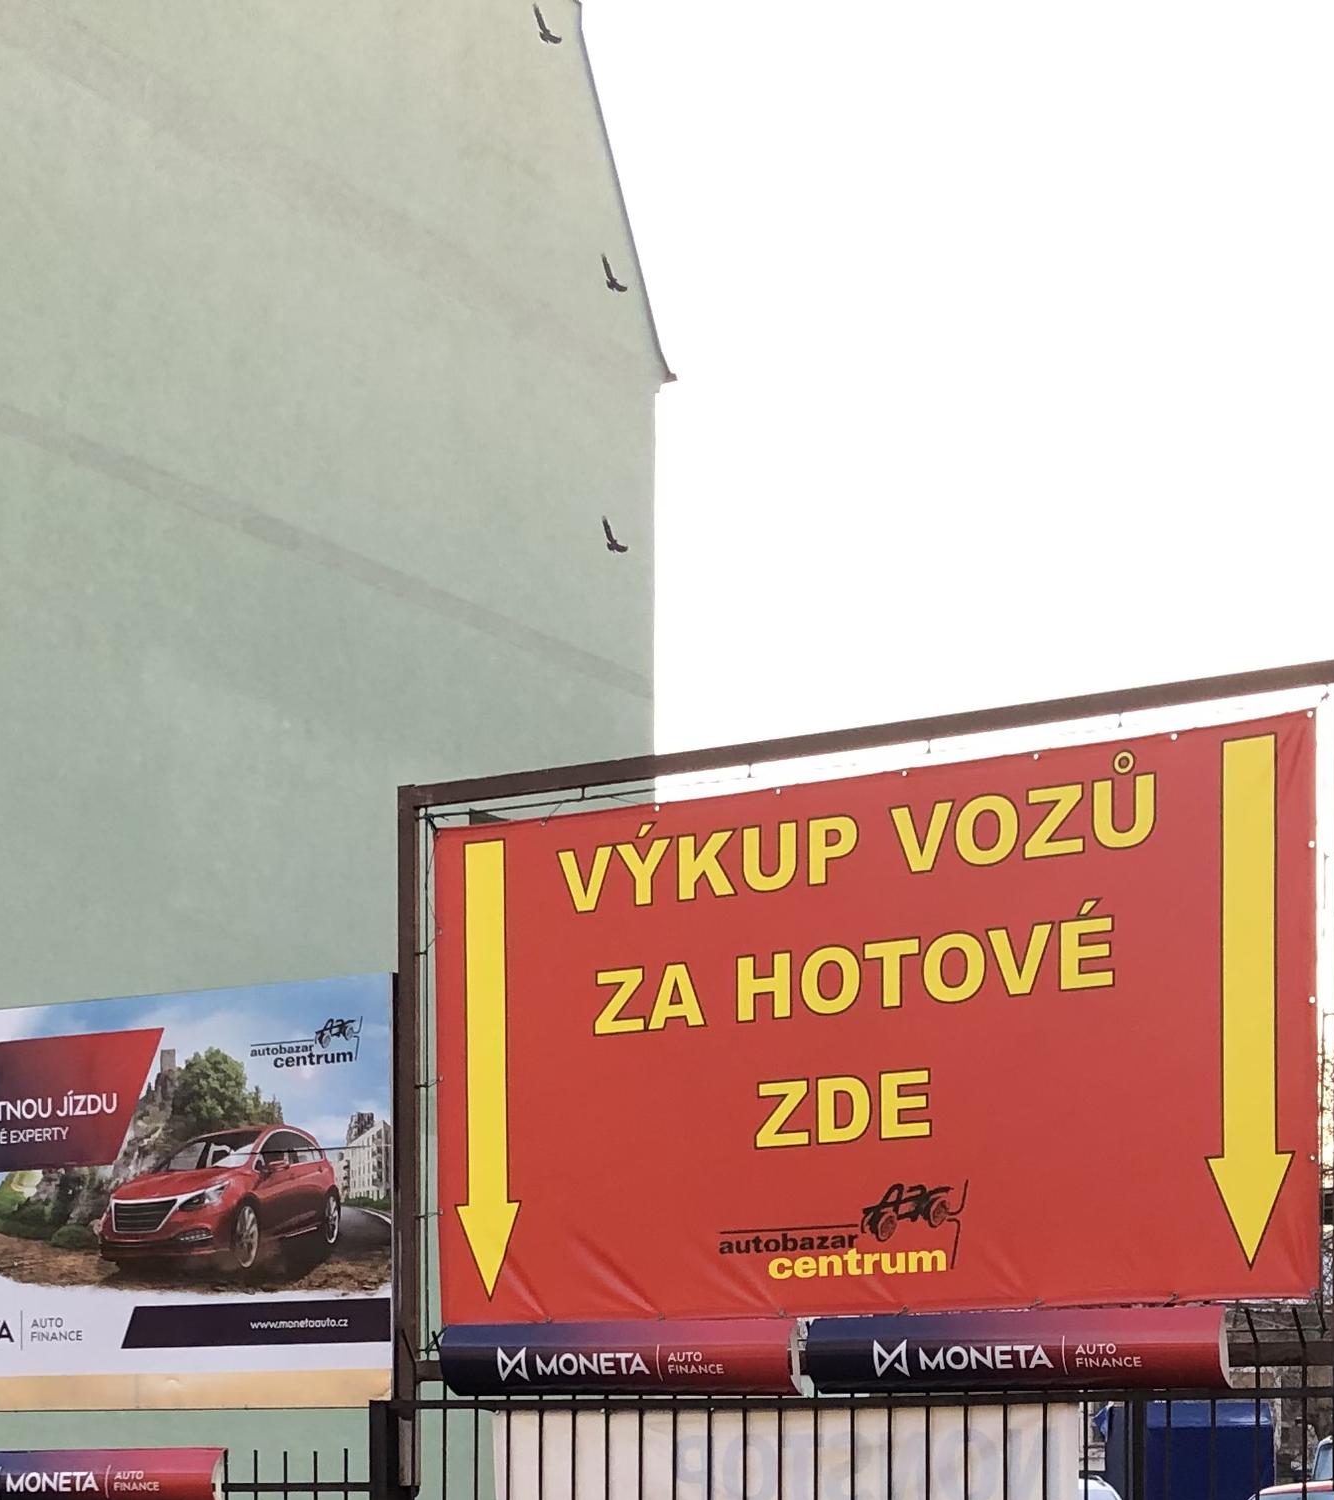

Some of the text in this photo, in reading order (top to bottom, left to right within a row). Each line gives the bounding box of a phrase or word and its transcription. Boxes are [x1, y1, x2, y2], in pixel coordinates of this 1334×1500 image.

[557, 750, 1158, 914] VÝKUP VOZŮ
[592, 899, 1116, 1037] ZA HOTOVÉ
[250, 1044, 314, 1057] autobazar
[273, 1051, 353, 1069] centrum
[56, 1090, 118, 1117] JÍZDU
[754, 1067, 932, 1151] ZDE
[10, 1126, 69, 1144] EXPERTY
[719, 1232, 858, 1254] autobazar
[768, 1248, 947, 1280] centrum
[30, 1317, 64, 1329] AUTO
[249, 1318, 349, 1331] www.monetaauto.cz
[30, 1330, 83, 1342] FINANCE
[535, 1351, 703, 1376] MONETA AUTO
[918, 1343, 1117, 1371] MONETA AUTO
[1075, 1356, 1143, 1369] FINANCE
[667, 1364, 724, 1375] FINANCE
[6, 1470, 144, 1493] MONETA AUTO
[113, 1481, 160, 1492] FINANCE
